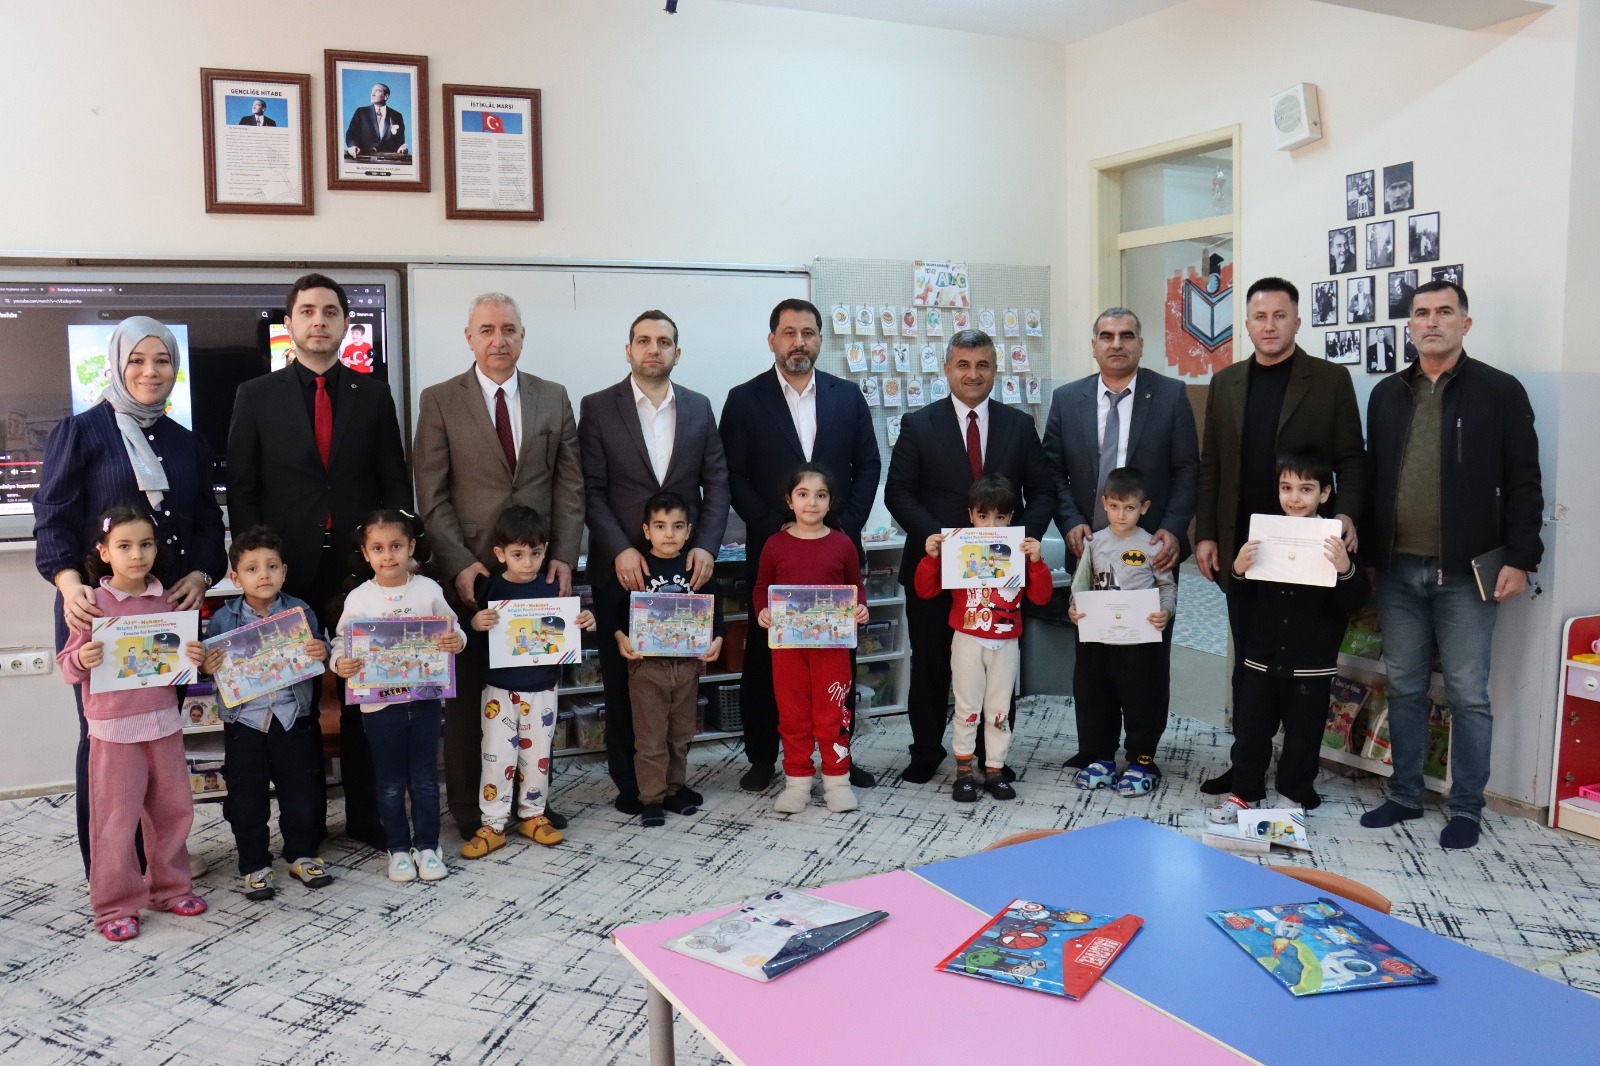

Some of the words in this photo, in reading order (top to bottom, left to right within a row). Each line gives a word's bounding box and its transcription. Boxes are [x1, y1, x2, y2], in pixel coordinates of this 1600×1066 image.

[230, 88, 260, 96] GENÇLİĞE
[968, 588, 990, 599] HO
[968, 610, 991, 622] HO
[378, 687, 411, 698] EXTRA!
